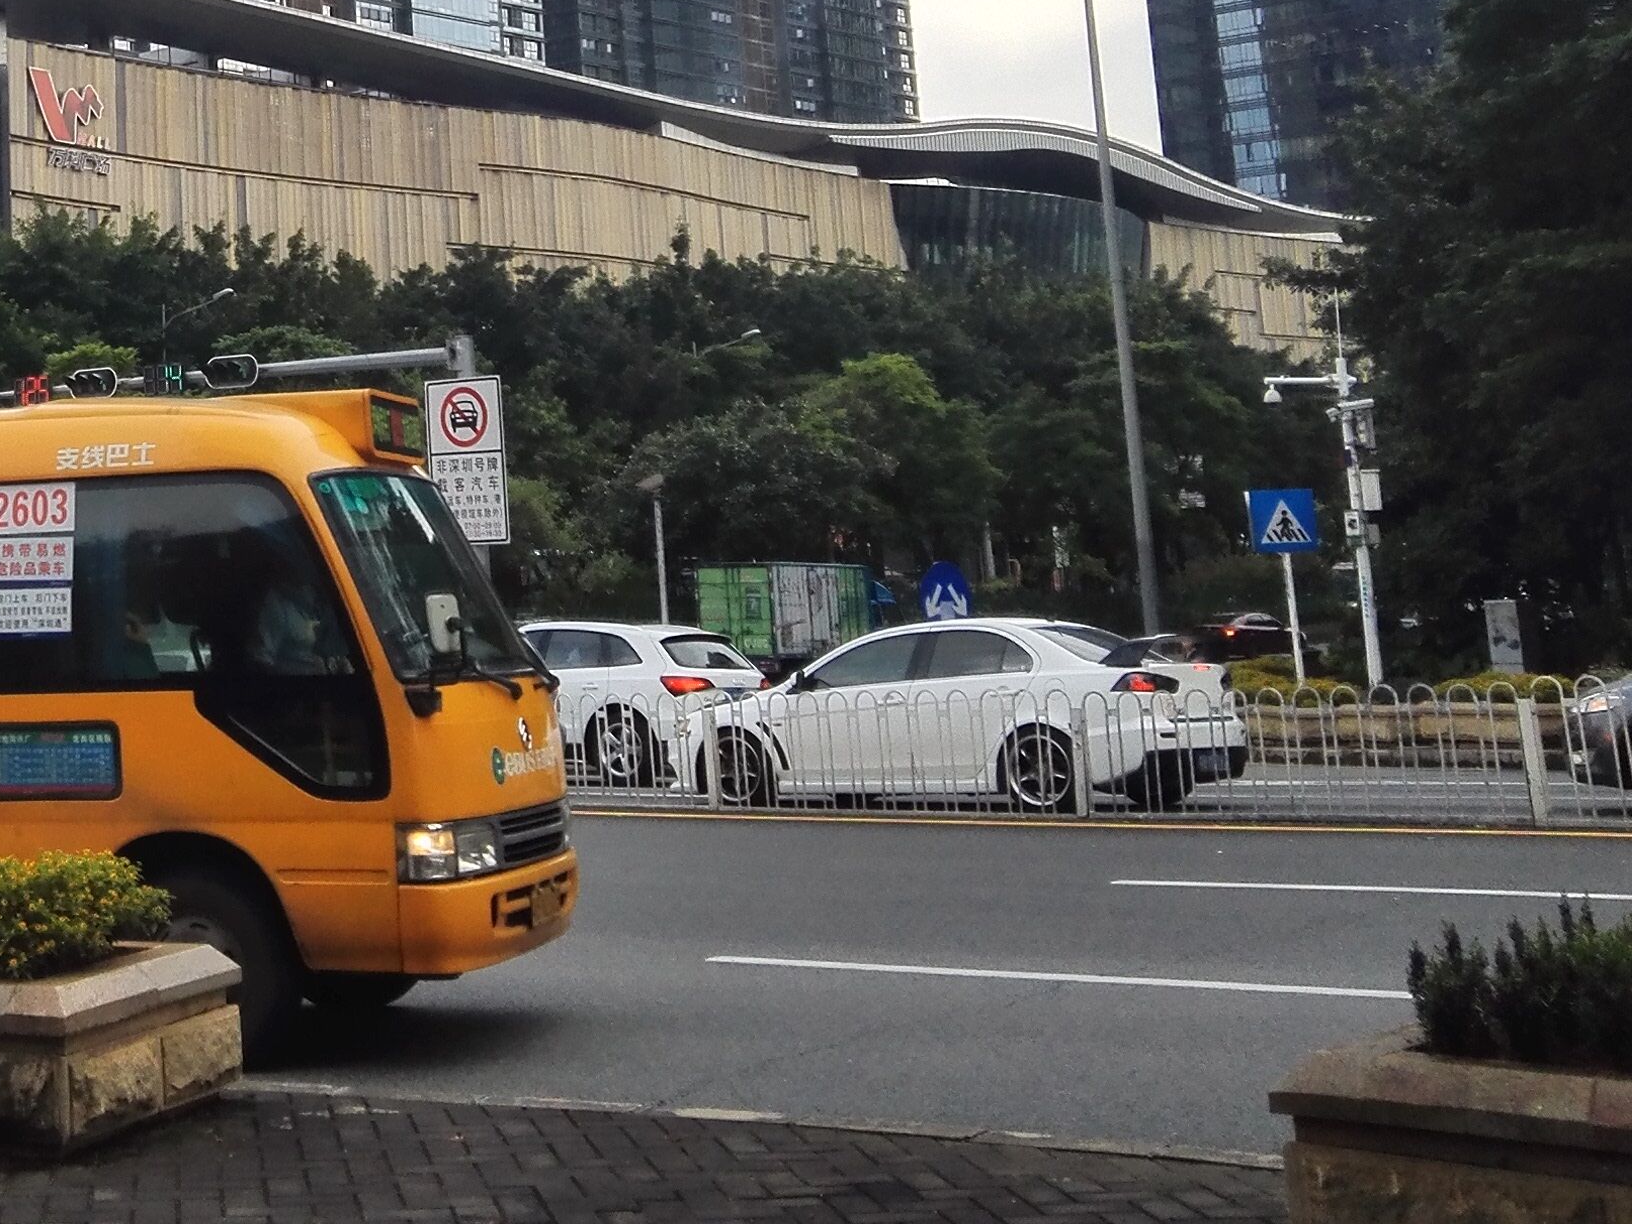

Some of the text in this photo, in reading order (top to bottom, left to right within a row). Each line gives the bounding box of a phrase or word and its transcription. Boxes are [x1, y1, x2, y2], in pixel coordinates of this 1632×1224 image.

[55, 441, 157, 470] 支线巴士
[436, 457, 499, 474] 非深圳号牌
[437, 476, 500, 493] 载客汽车
